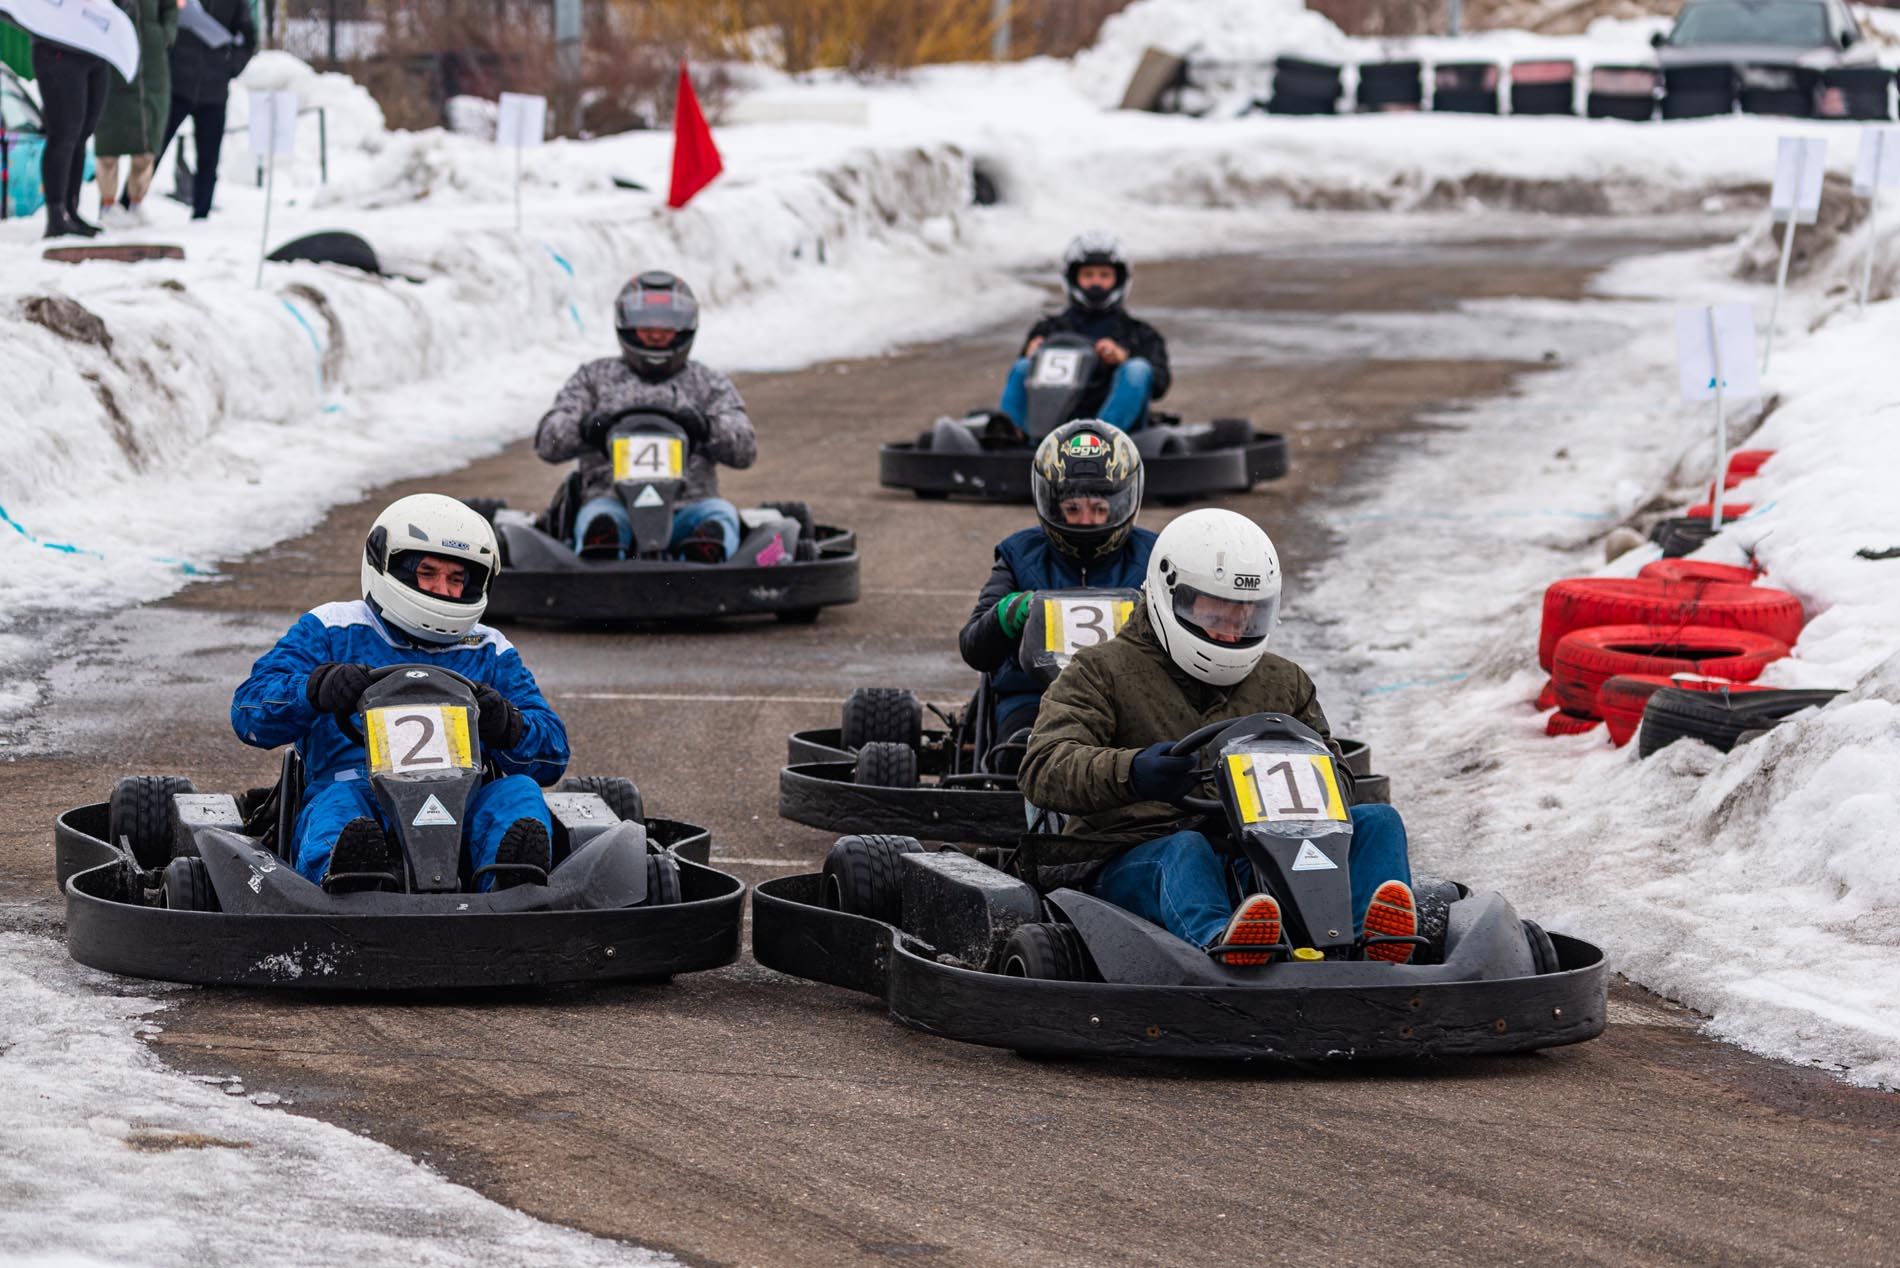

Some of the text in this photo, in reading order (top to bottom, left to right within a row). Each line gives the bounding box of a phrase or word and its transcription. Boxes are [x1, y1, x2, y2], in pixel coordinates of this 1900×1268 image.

[1046, 355, 1072, 381] 5
[633, 443, 665, 472] 4
[1071, 446, 1099, 456] agv
[1234, 576, 1261, 588] OMP
[1070, 605, 1108, 649] 3
[394, 715, 444, 766] 2
[1267, 761, 1319, 814] 1
